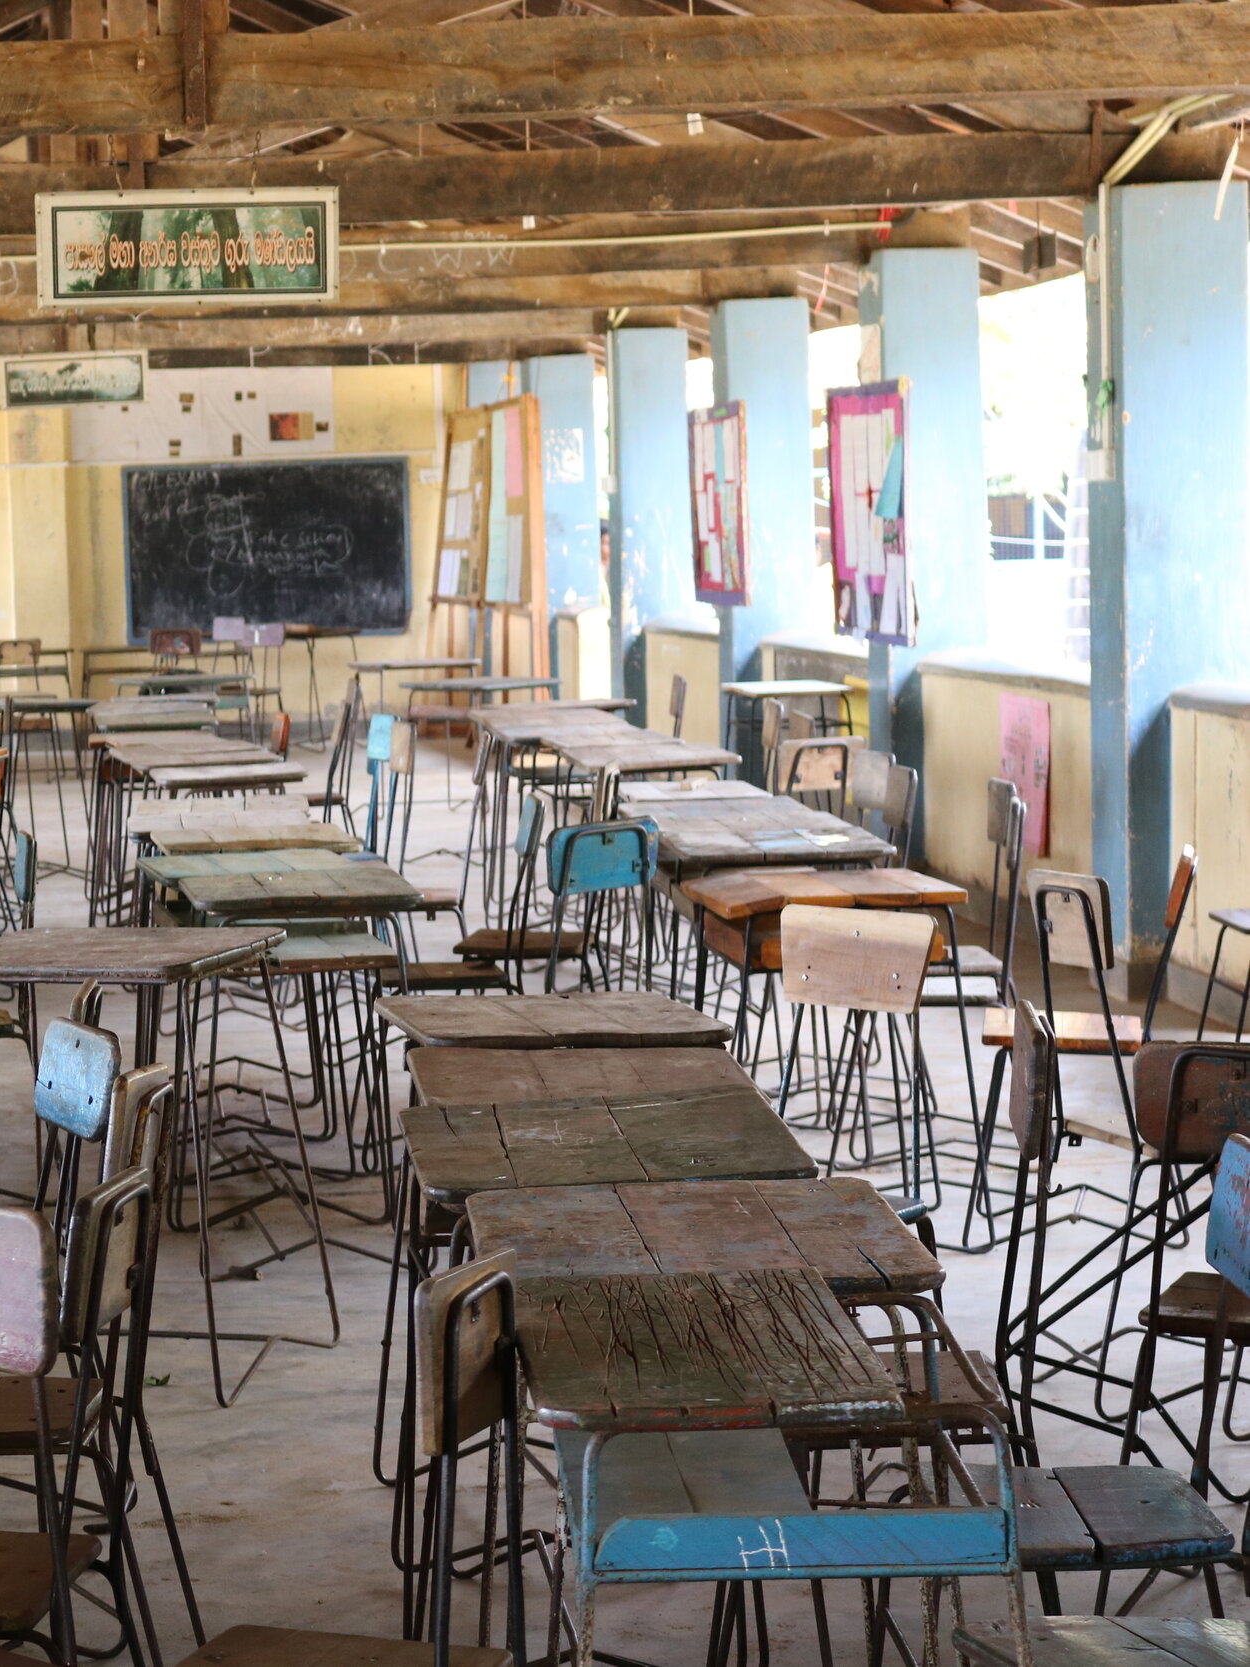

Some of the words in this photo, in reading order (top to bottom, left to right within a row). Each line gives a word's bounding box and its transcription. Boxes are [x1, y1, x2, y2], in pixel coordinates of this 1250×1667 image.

[108, 232, 135, 270] මහා
[180, 230, 221, 274] වස්තුව
[224, 231, 251, 274] ගුරු
